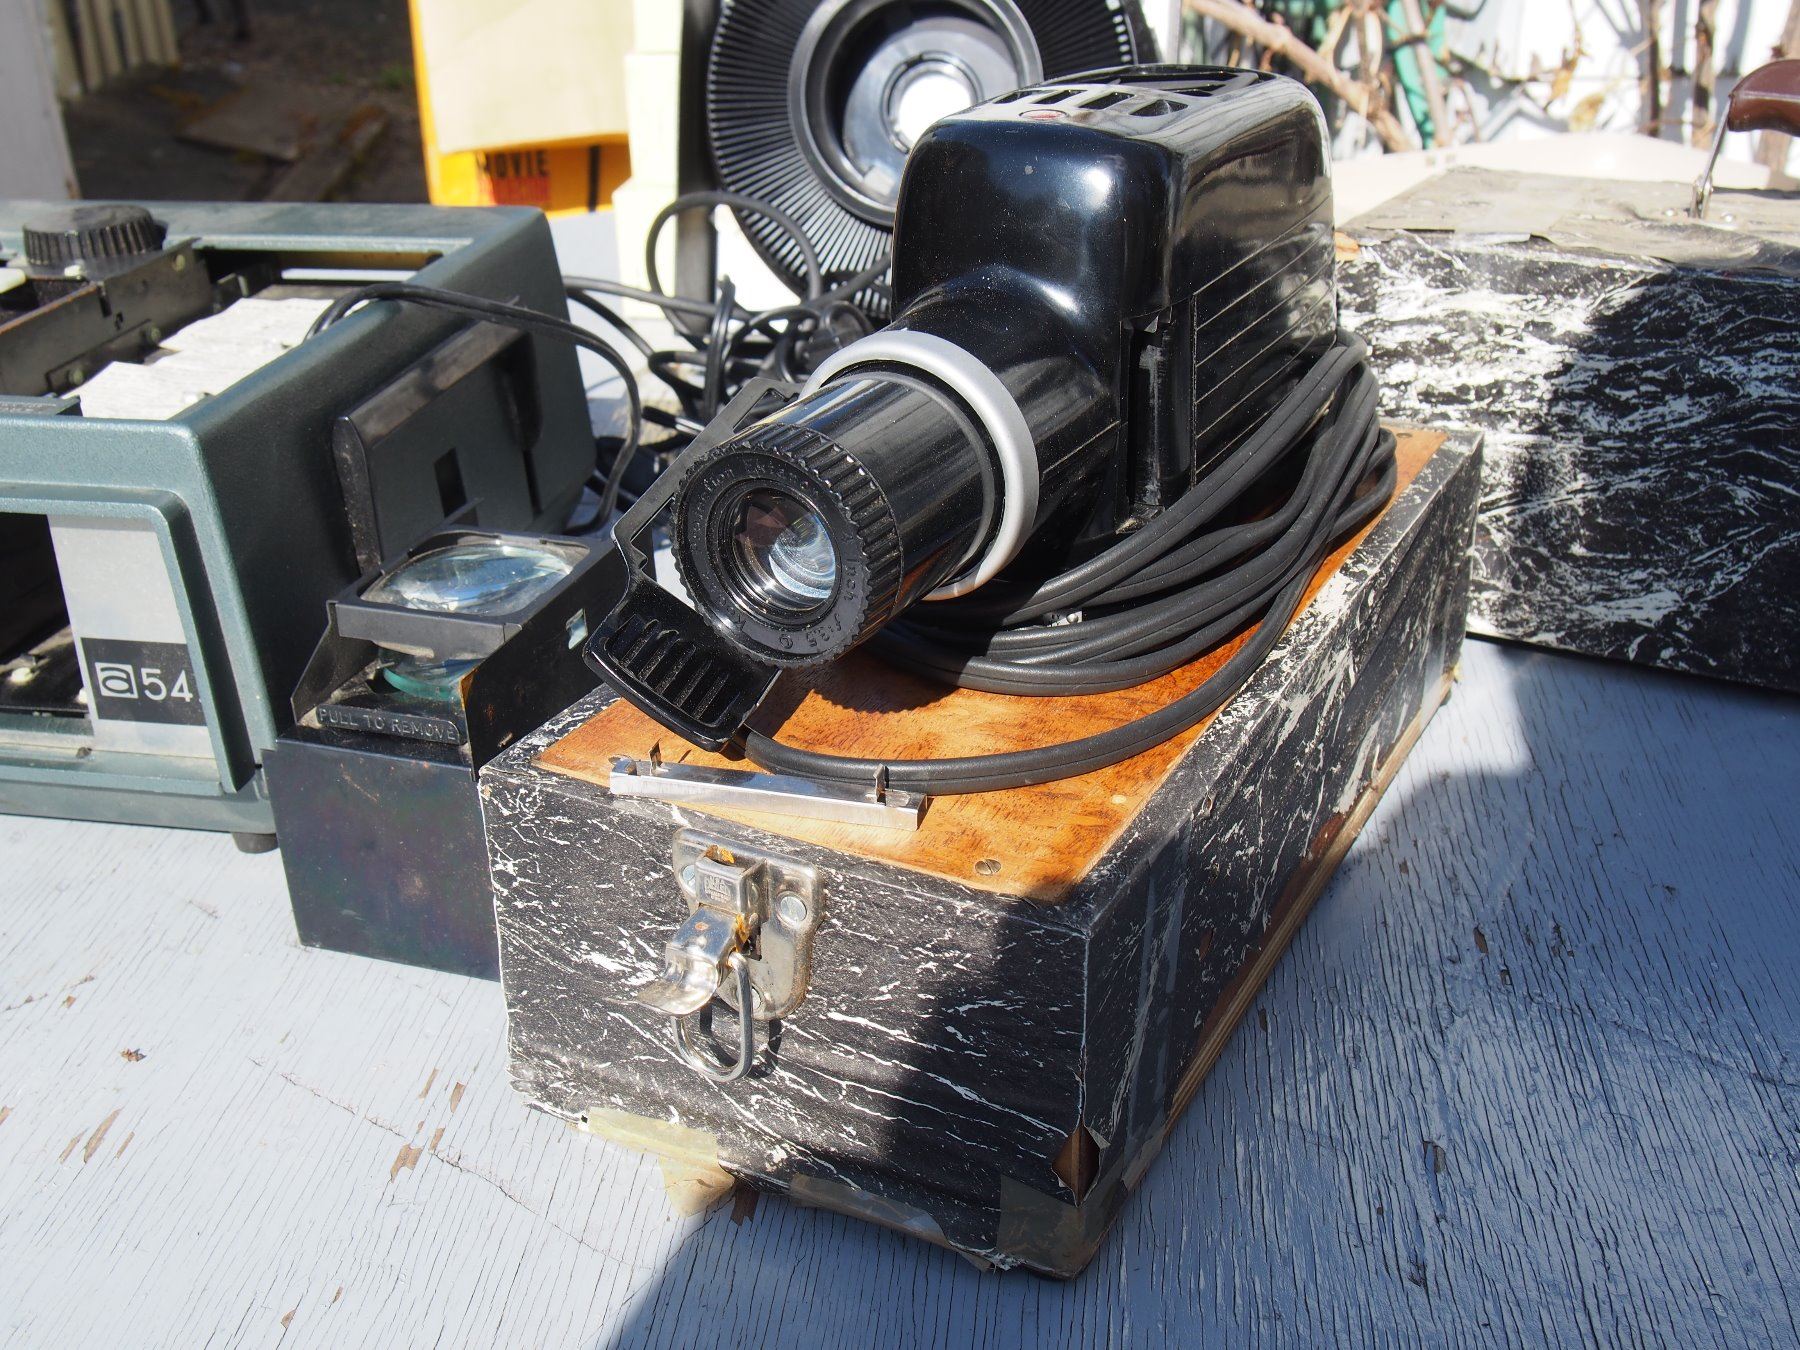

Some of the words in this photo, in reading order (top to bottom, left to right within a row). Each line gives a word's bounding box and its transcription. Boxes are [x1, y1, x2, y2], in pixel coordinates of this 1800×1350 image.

[318, 708, 358, 727] PULL
[363, 714, 385, 730] TO
[391, 719, 456, 741] REMOVE
